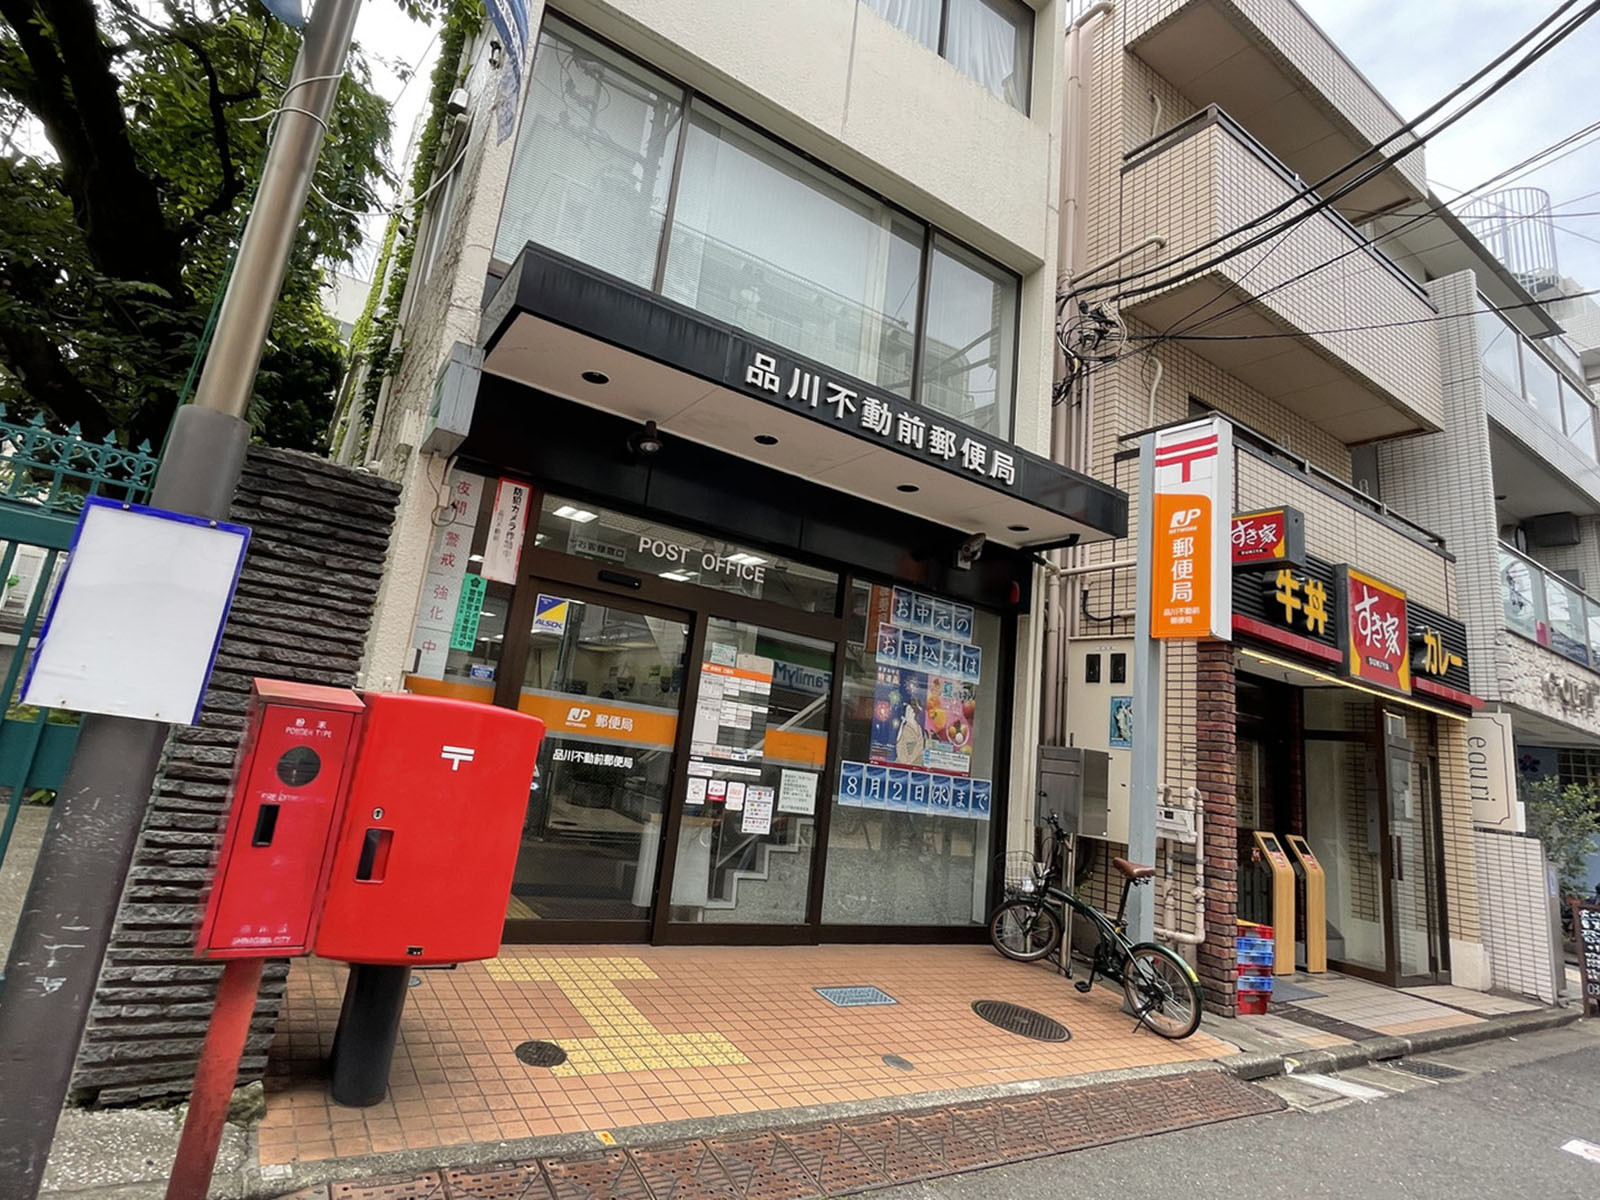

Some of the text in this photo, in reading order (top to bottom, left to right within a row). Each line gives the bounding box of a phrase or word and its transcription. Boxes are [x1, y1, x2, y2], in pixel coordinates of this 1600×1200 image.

[745, 352, 1016, 486] 品川不動前郵便局
[1232, 520, 1278, 548] すき家
[638, 537, 766, 583] POST OFFICE
[1171, 536, 1194, 603] 郵便局
[896, 602, 969, 632] お中元の
[1275, 569, 1328, 635] 牛丼
[1354, 585, 1401, 659] すき家
[882, 636, 977, 674] お申込みは
[1424, 627, 1463, 676] カレー
[595, 714, 633, 732] 郵便局
[552, 748, 633, 769] 品川不動前郵便局
